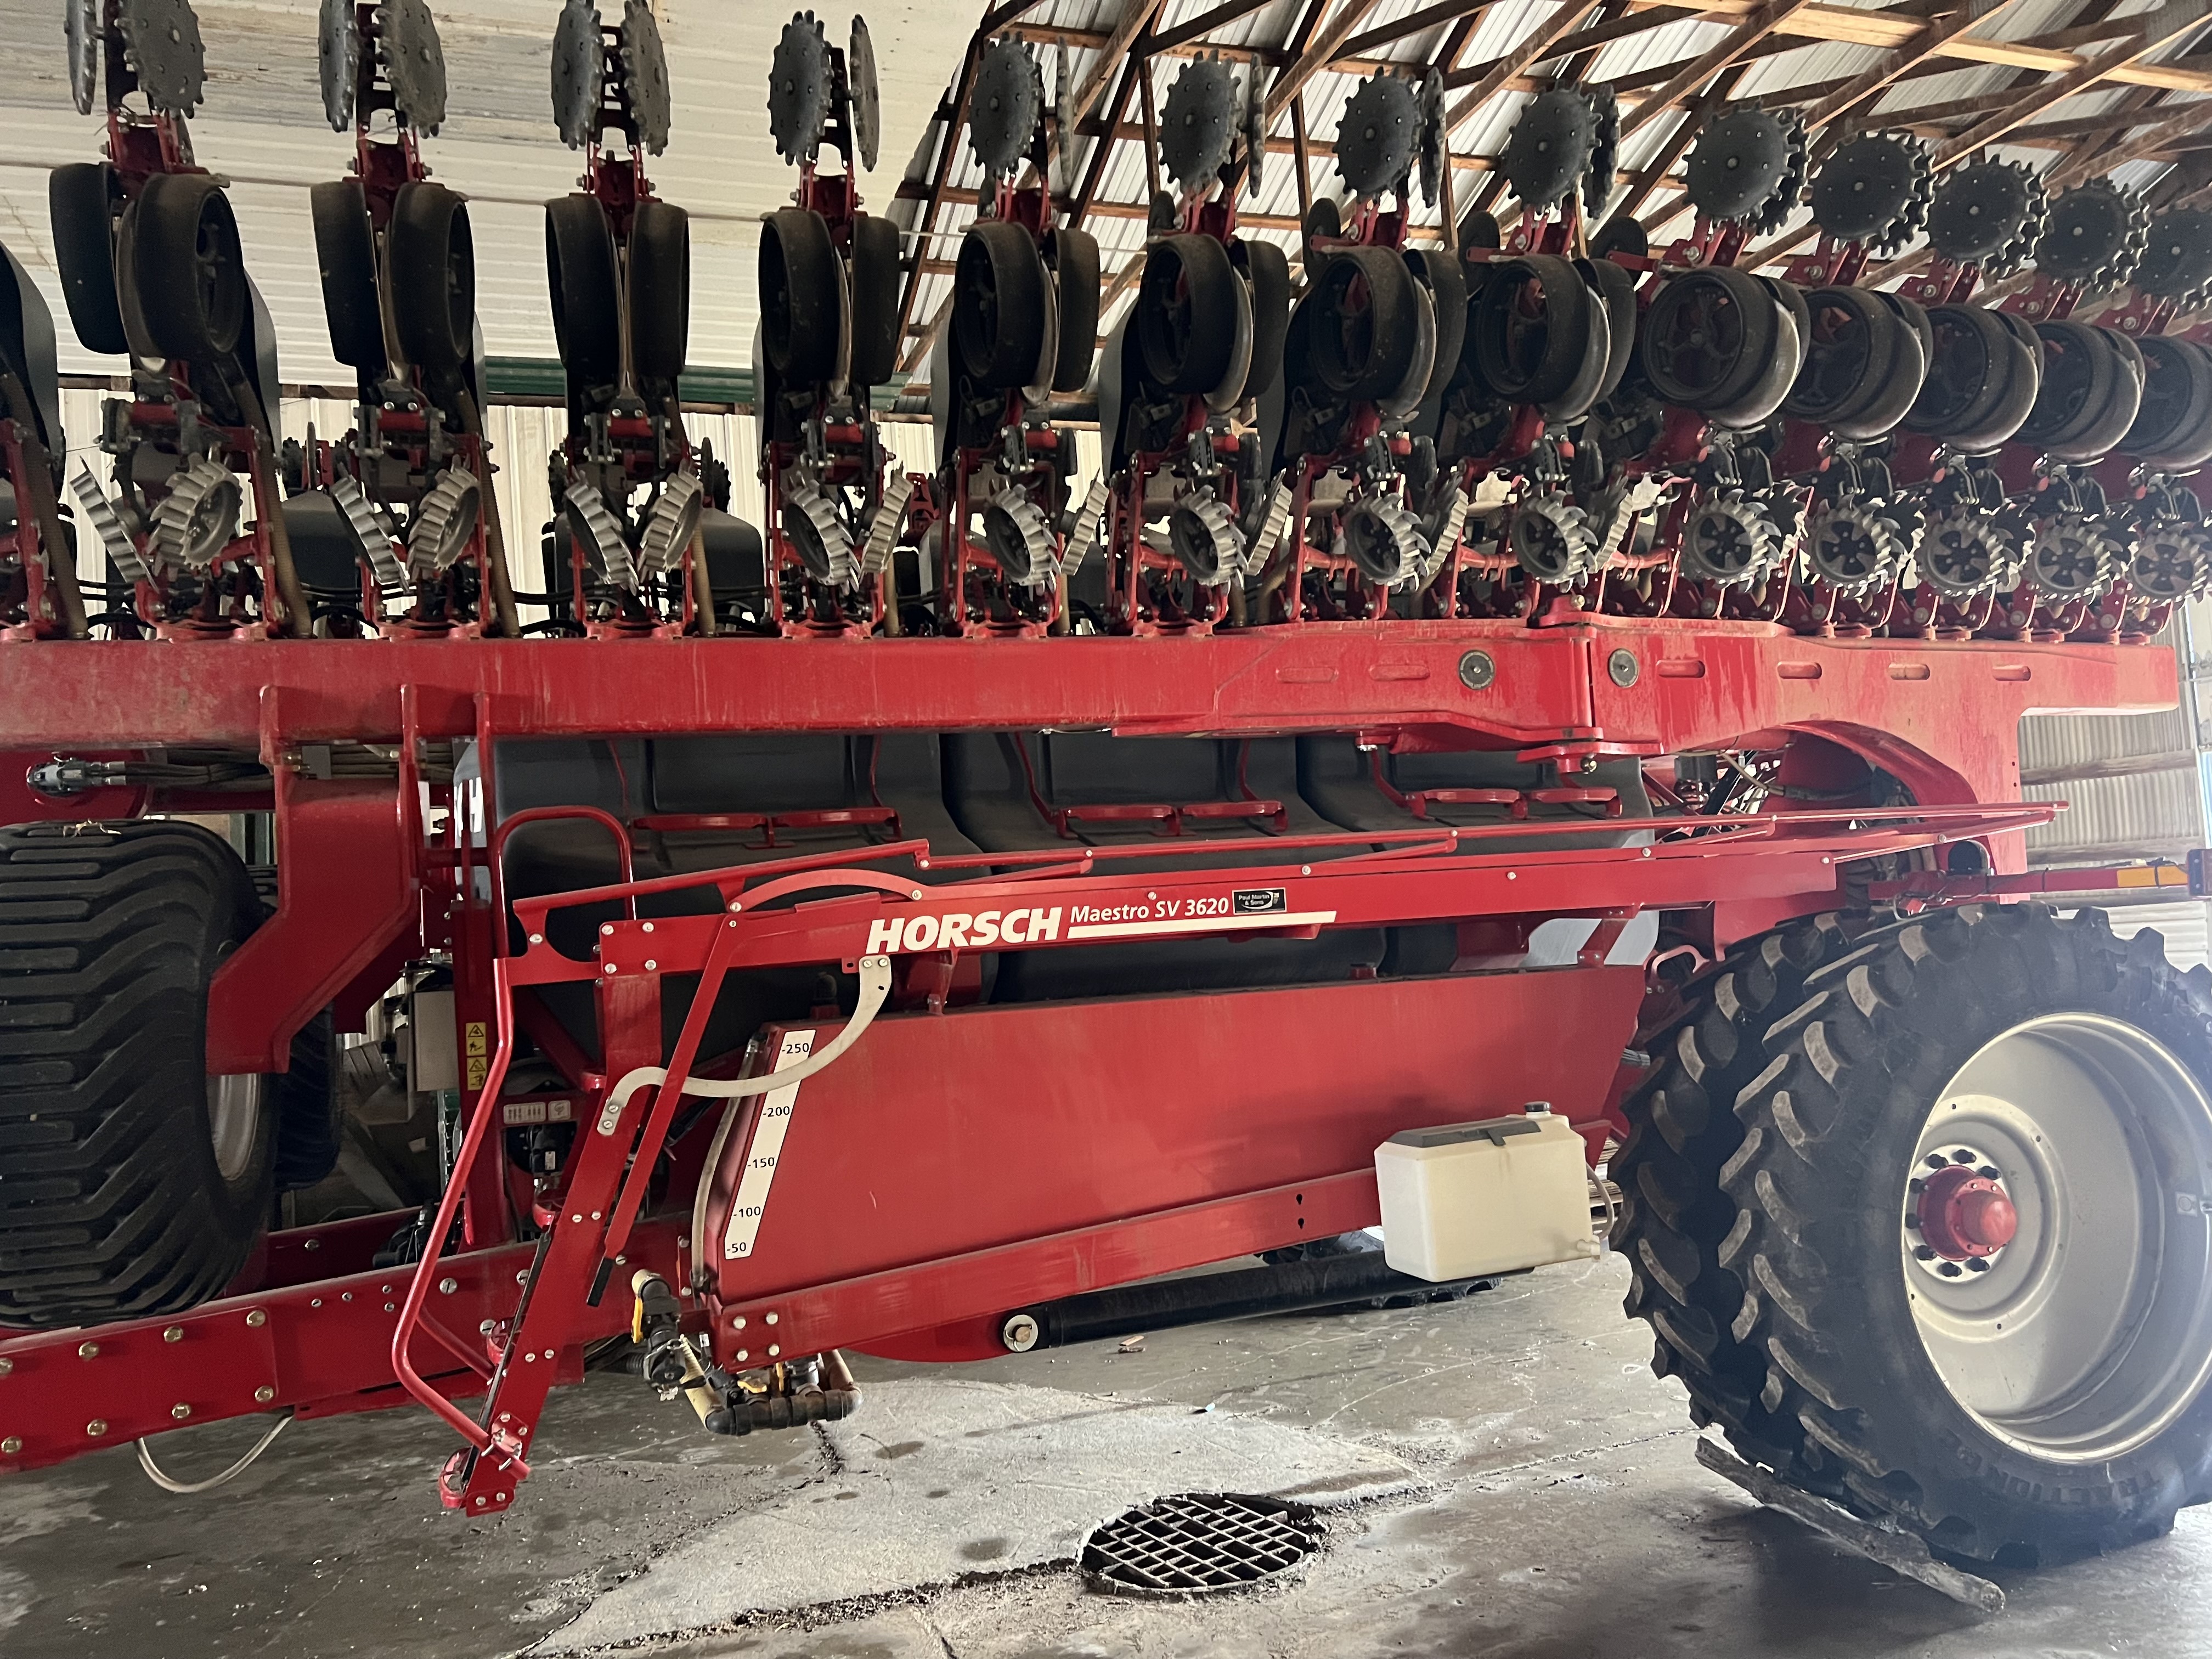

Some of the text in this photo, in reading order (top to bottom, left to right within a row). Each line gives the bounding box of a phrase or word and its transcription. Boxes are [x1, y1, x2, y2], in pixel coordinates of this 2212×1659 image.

[866, 897, 1229, 955] HORSCH Maestro SV 3620
